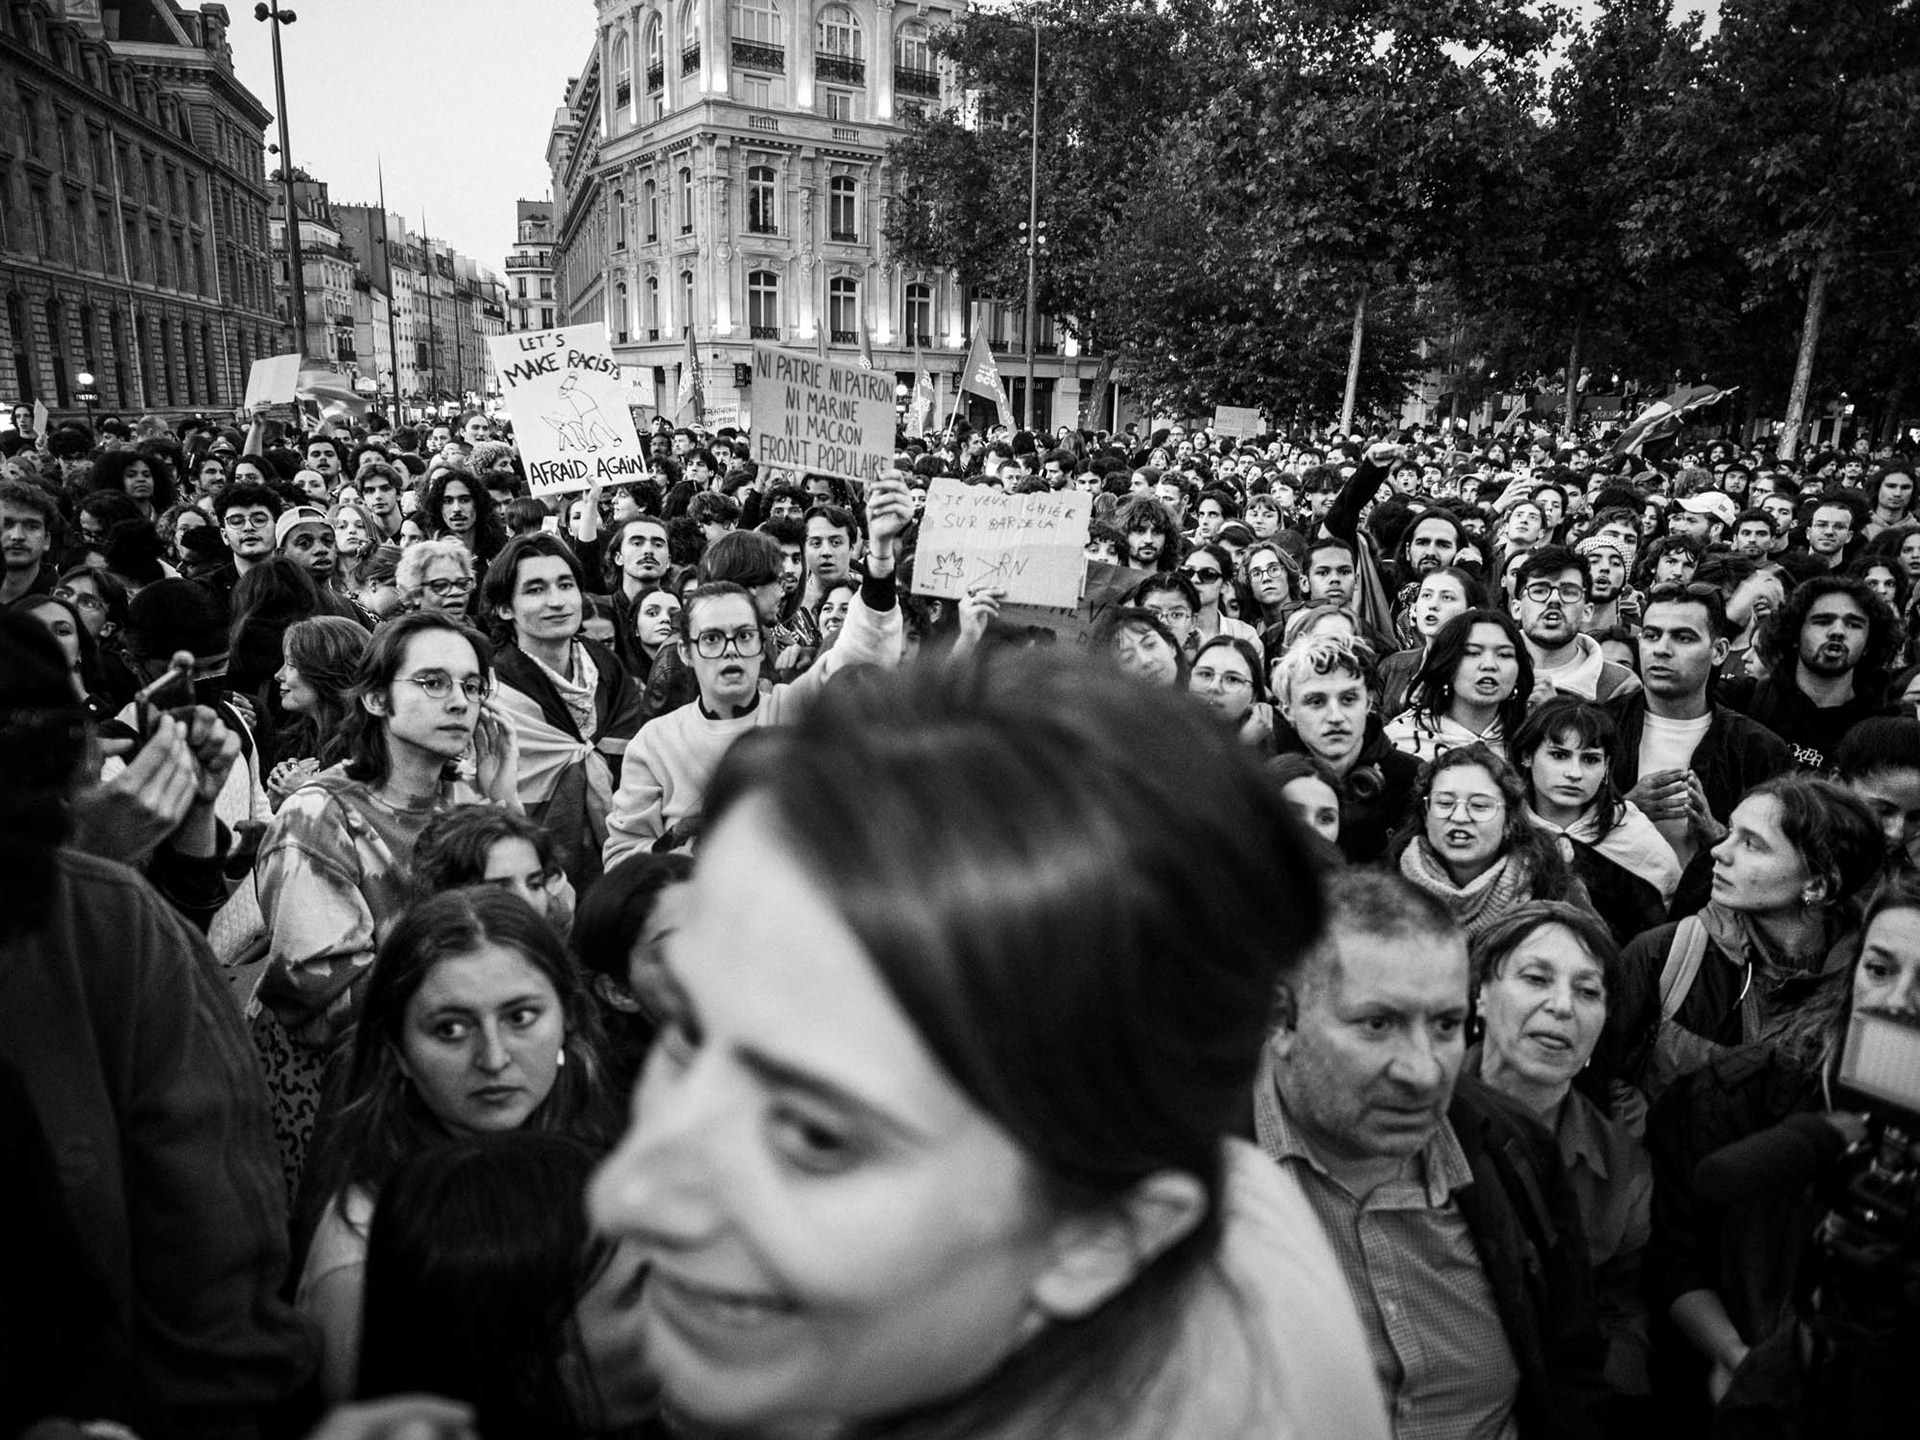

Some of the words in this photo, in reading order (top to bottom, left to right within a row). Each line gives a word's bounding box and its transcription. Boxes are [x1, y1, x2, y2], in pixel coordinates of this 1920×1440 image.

[519, 333, 565, 351] LET'S
[503, 352, 560, 387] MAKE
[567, 350, 621, 380] RACISTS
[757, 351, 771, 379] NI
[776, 355, 823, 388] PATRIE
[829, 369, 841, 392] NI
[845, 370, 894, 403] PATRON
[785, 386, 800, 411] NI
[807, 391, 859, 423] MARINE
[785, 415, 799, 437] NI
[807, 415, 863, 446] MACRON
[529, 458, 588, 487] AFRAID
[597, 454, 644, 482] AGAIN
[760, 433, 811, 470] FRONT
[818, 444, 888, 481] POPULAIRE
[943, 512, 977, 529] SUR
